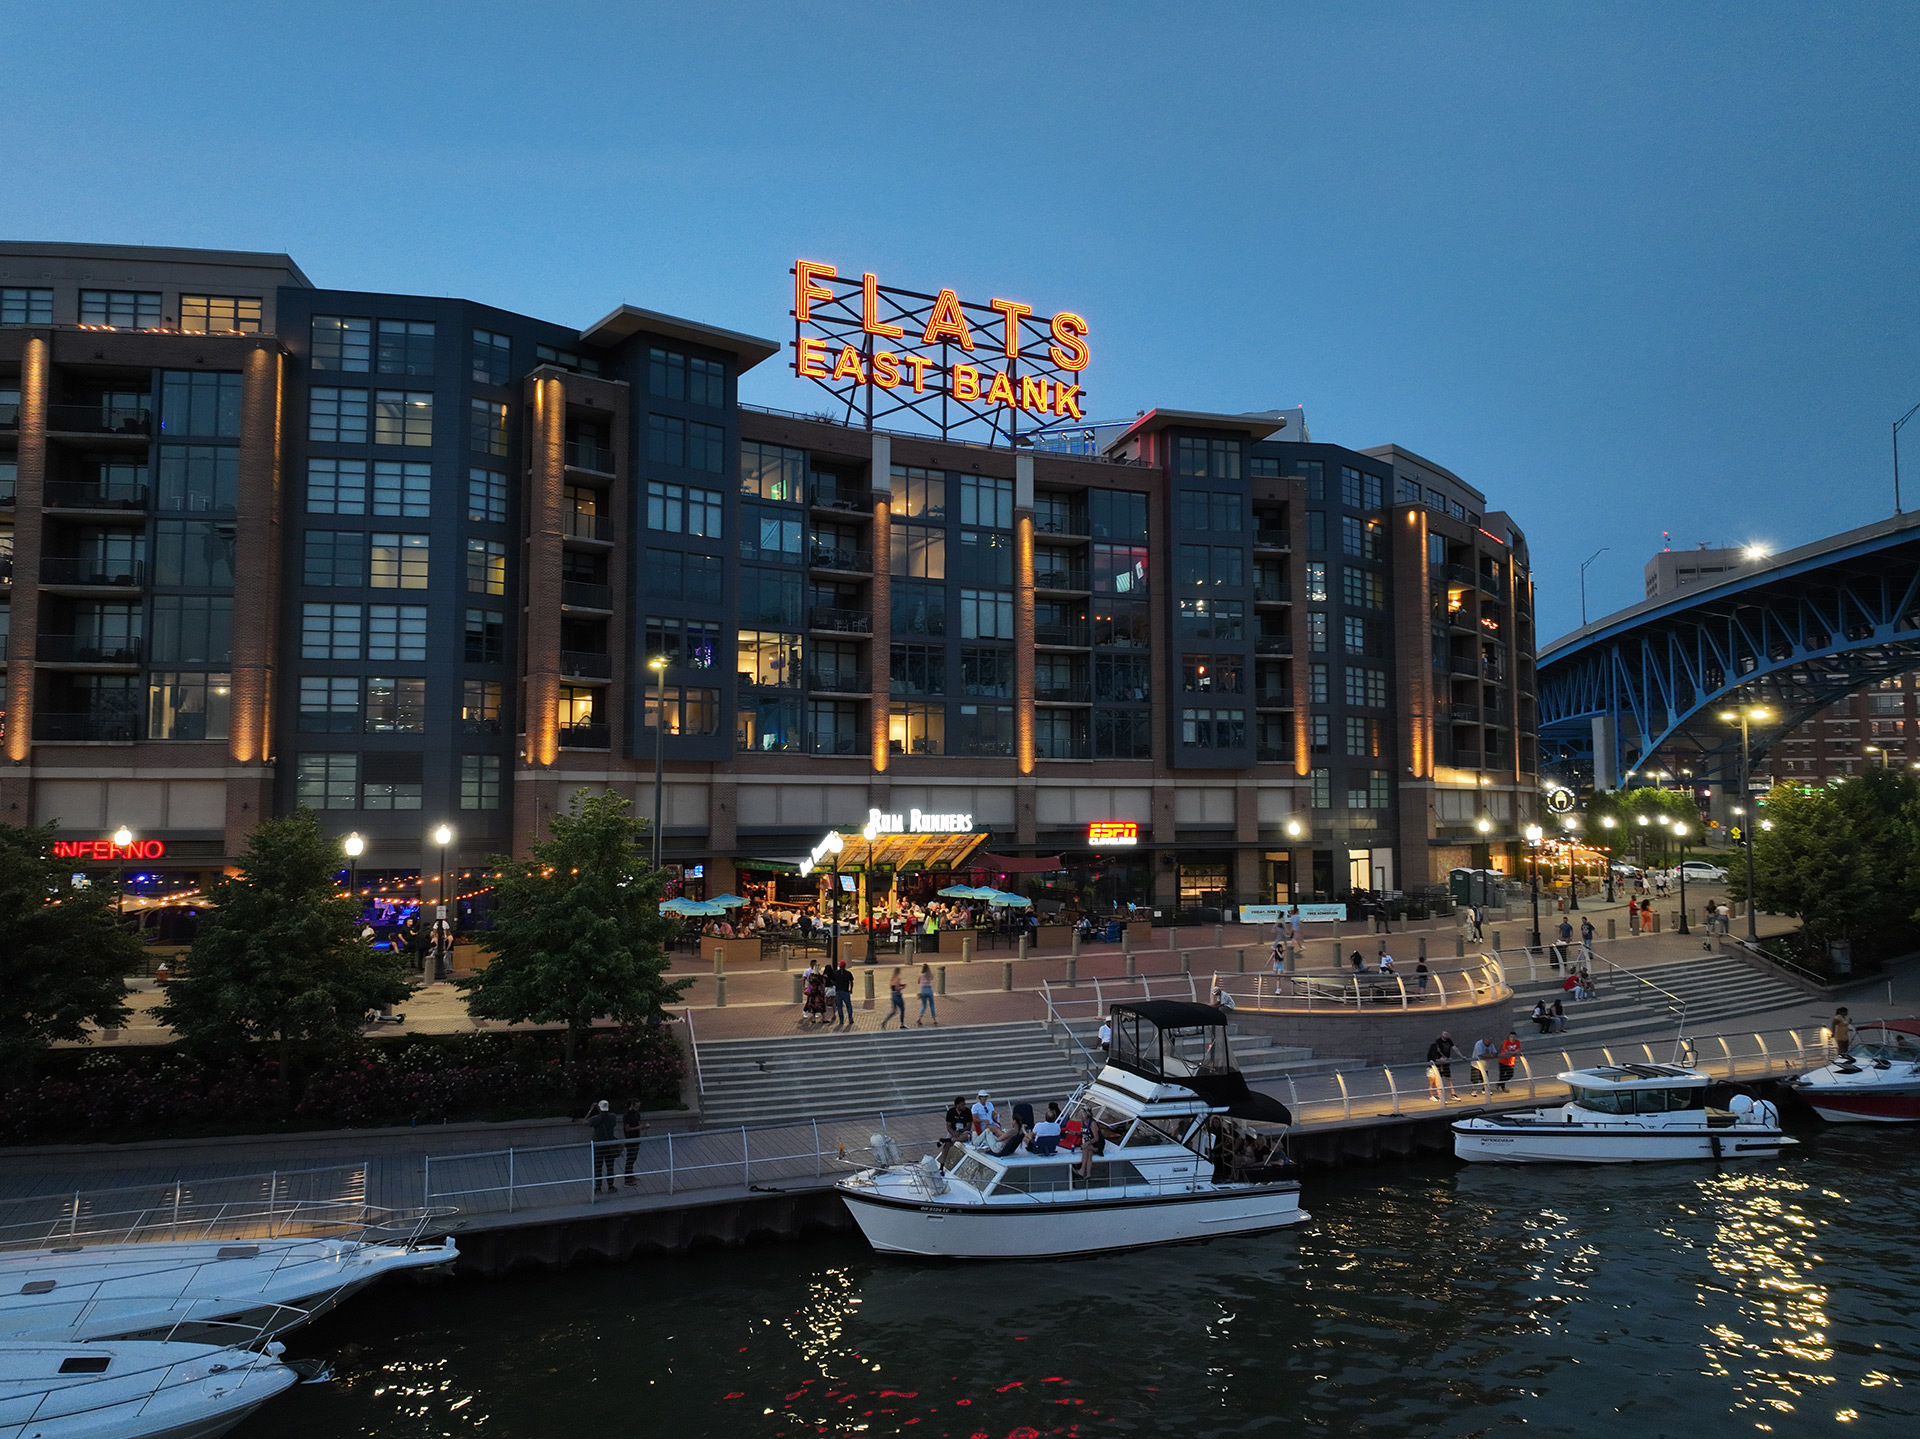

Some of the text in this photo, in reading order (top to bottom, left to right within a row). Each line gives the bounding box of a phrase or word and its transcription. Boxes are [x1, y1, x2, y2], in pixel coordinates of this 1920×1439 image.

[796, 259, 1090, 371] FLATS
[799, 337, 1081, 419] EAST BANK
[1089, 822, 1137, 838] ESPN
